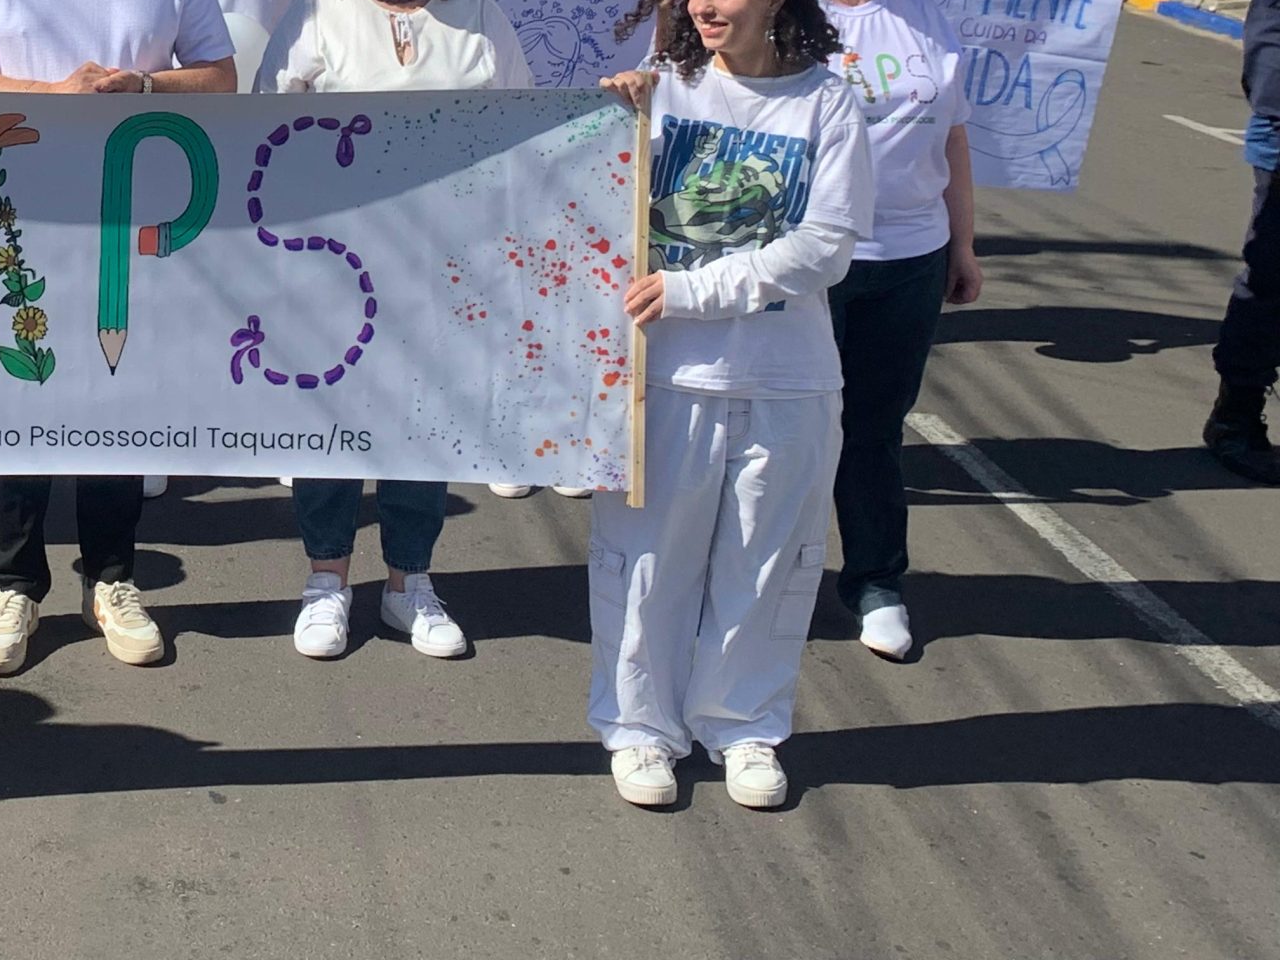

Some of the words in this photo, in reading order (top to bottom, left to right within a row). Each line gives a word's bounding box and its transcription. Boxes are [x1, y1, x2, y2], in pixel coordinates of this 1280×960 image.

[959, 17, 1017, 41] CUIDA
[1023, 29, 1048, 45] DA
[961, 47, 1033, 110] IDA
[30, 424, 198, 449] Psicossocial
[206, 423, 373, 457] Taquara/RS
